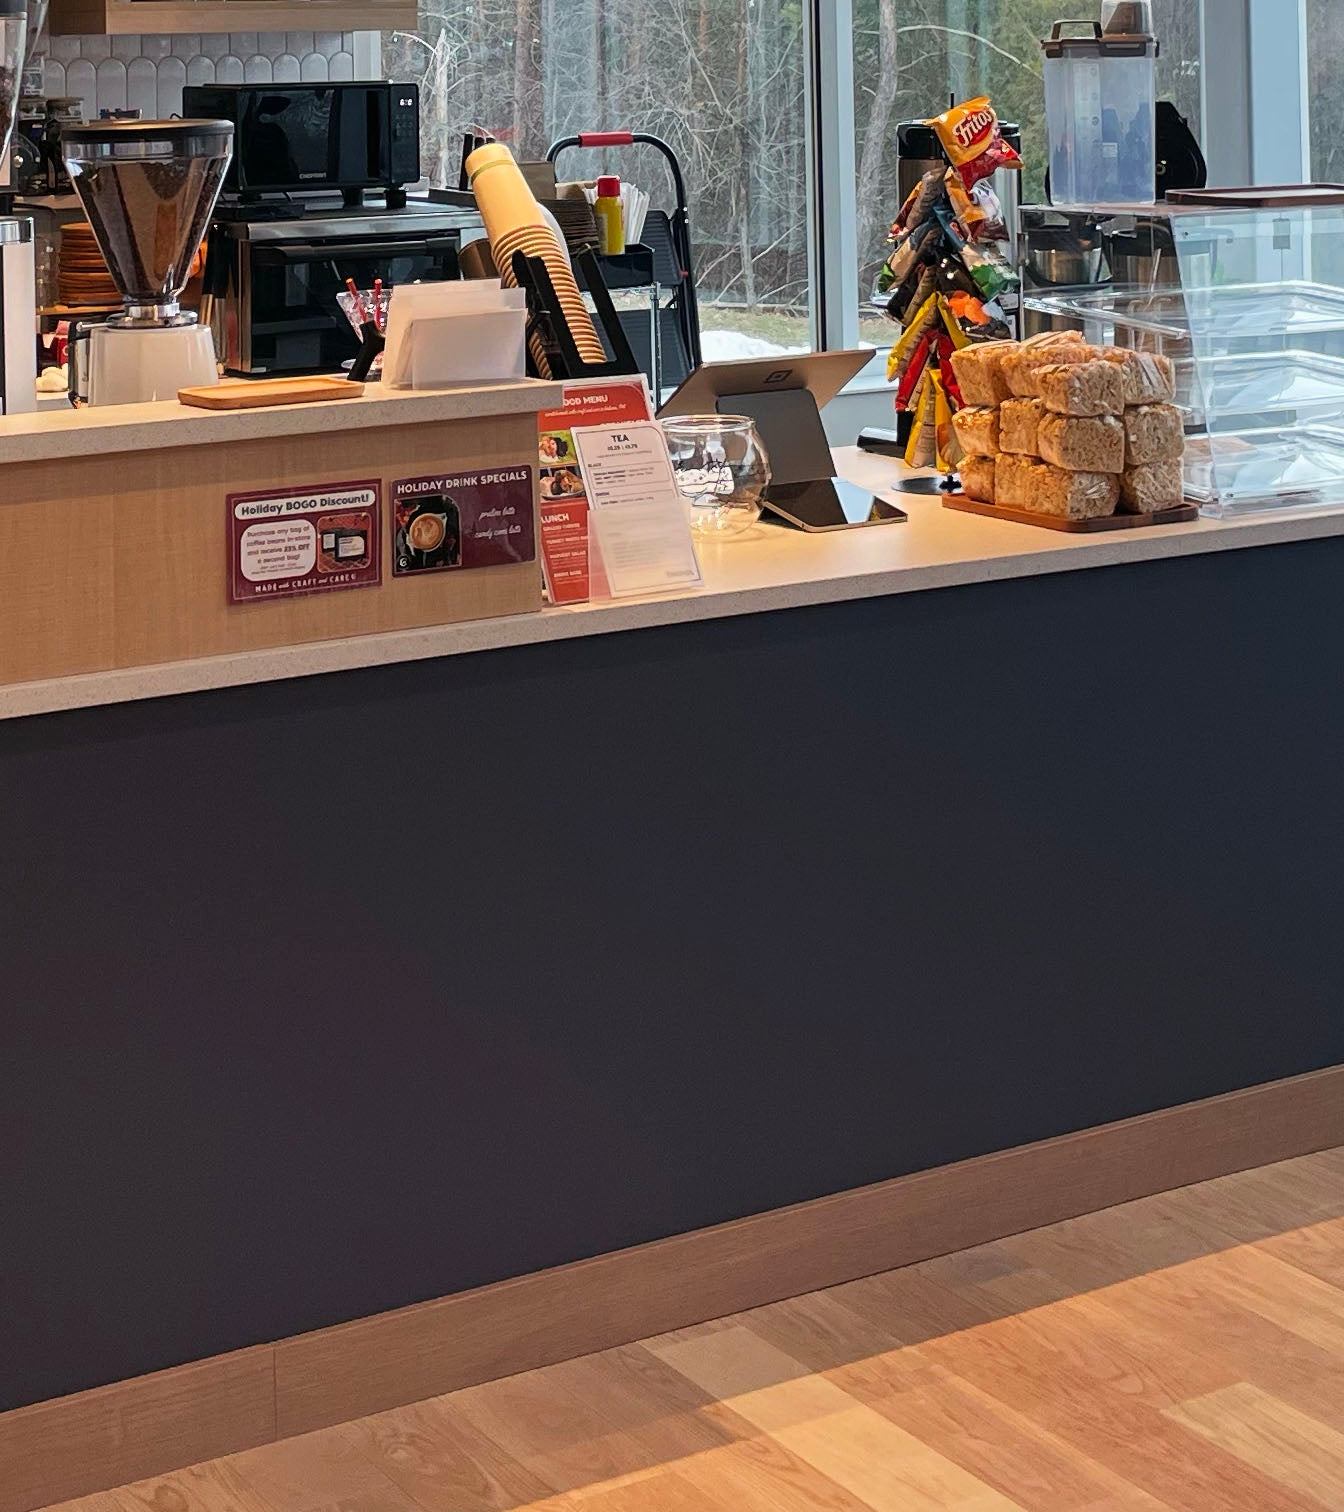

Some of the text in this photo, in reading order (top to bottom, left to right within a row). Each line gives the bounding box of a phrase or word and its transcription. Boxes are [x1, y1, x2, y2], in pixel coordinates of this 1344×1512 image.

[583, 394, 608, 405] MENU
[611, 434, 630, 443] TEA
[397, 470, 528, 494] HOLIDAY DRINK SPECIALS
[241, 493, 370, 516] Holiday BOGO Discount!
[255, 582, 278, 593] MADE
